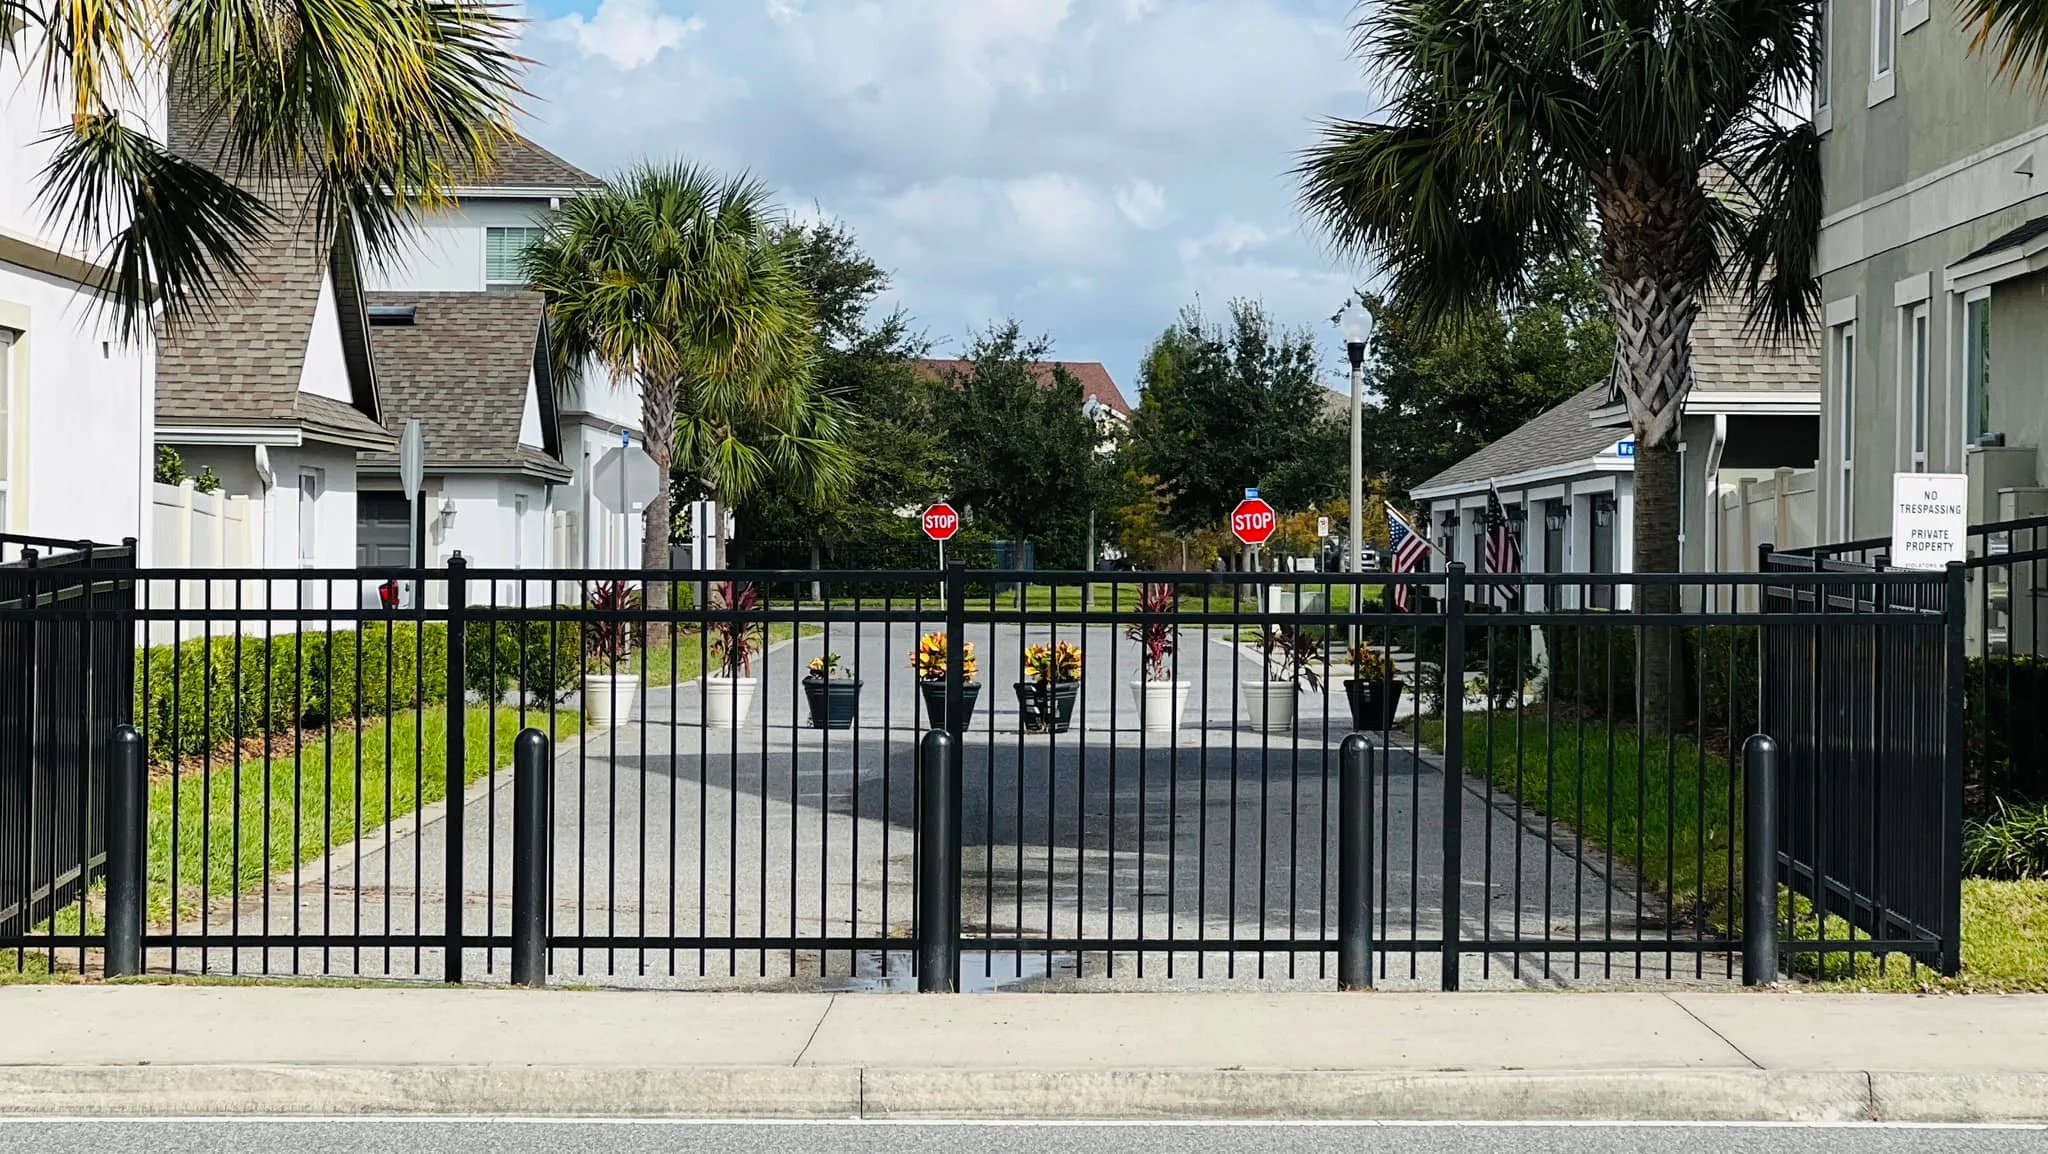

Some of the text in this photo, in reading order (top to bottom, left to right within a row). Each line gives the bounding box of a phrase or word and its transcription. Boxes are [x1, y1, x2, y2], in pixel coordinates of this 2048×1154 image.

[1924, 490, 1938, 501] NO
[1900, 504, 1961, 515] TRESPASSING
[926, 514, 955, 529] STOP
[1235, 512, 1272, 530] STOP
[1911, 529, 1949, 540] PRIVATE
[1905, 541, 1954, 552] PROPERTY
